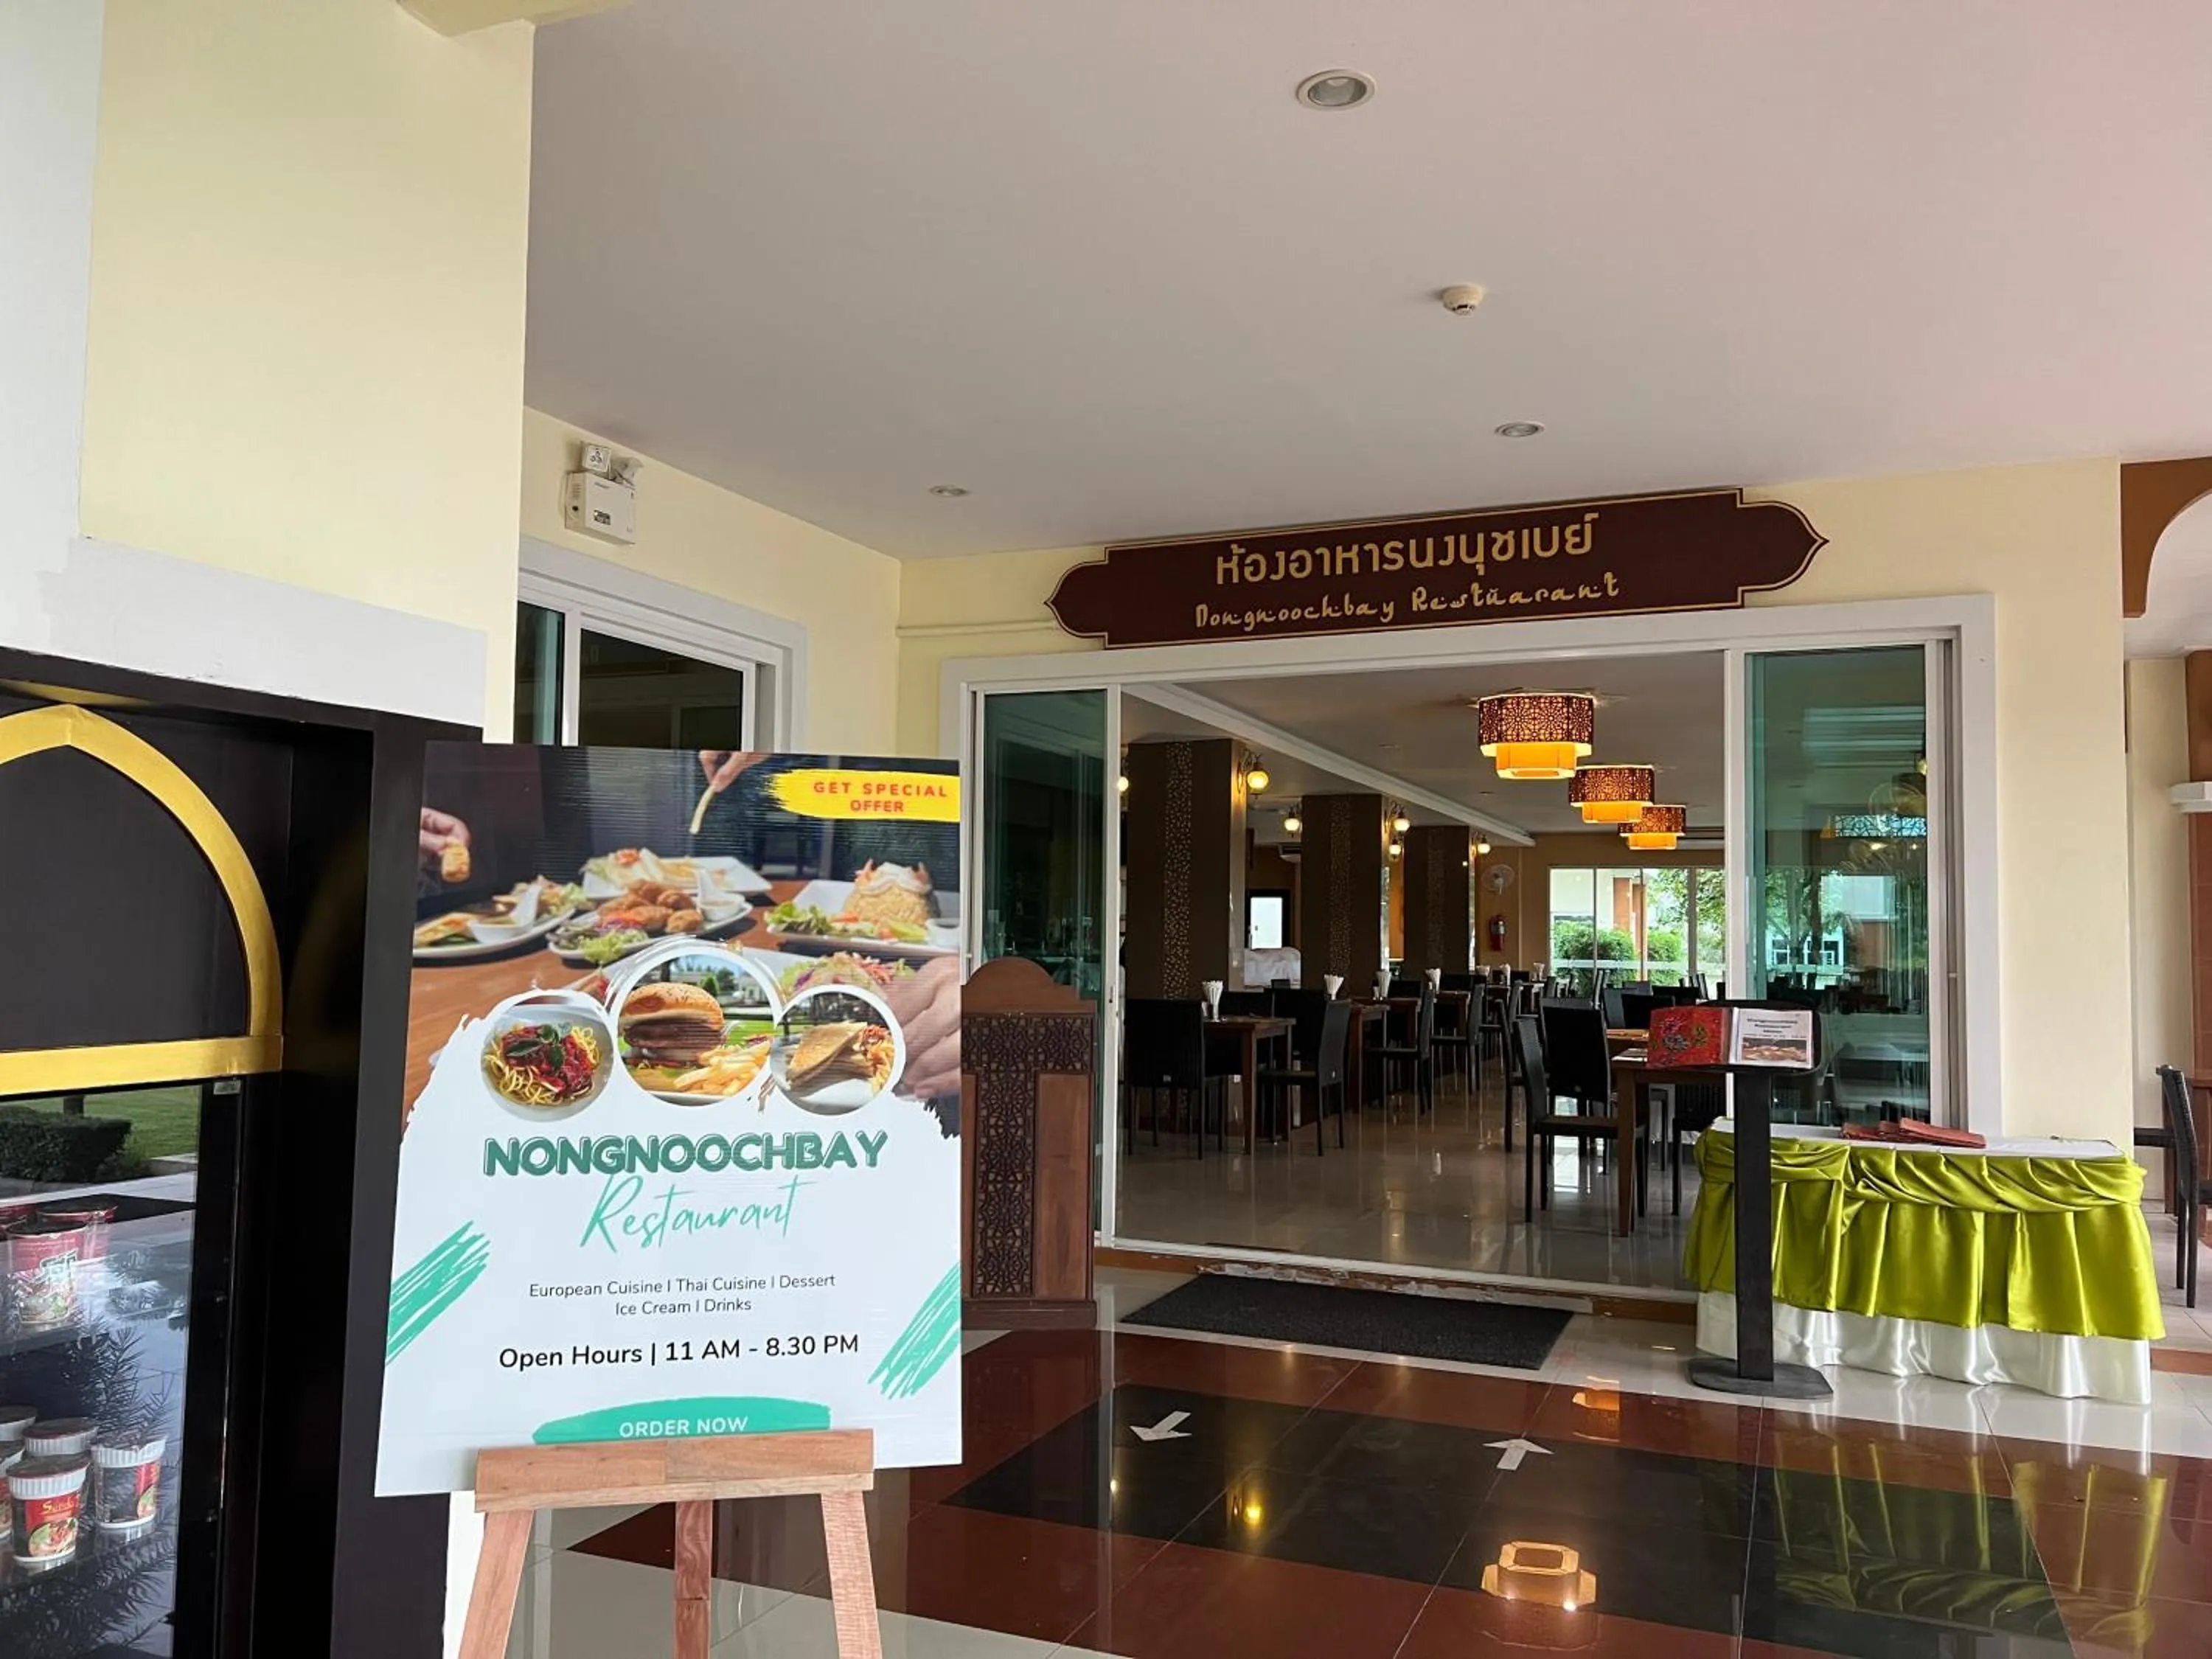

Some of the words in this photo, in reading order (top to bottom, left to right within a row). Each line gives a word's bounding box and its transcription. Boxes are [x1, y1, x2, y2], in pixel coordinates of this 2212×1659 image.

[1217, 512, 1599, 585] ห้องอาหารนงนุชเบย์
[813, 782, 851, 794] GET
[863, 782, 946, 798] SPECIAL
[850, 800, 903, 813] OFFER
[483, 1130, 888, 1176] NONGNOOCHBAY
[579, 1175, 819, 1253] Restaurant
[529, 1284, 602, 1298] European
[607, 1281, 663, 1295] Cuisine
[676, 1278, 707, 1293] Thai
[712, 1277, 766, 1291] Cuisine
[779, 1275, 835, 1288] Dessert
[616, 1302, 637, 1316] Ice
[641, 1301, 691, 1315] Cream
[704, 1297, 751, 1312] Drinks
[499, 1348, 563, 1372] Open
[572, 1345, 642, 1365] Hours
[666, 1341, 694, 1361] 11
[701, 1339, 740, 1360] AM
[766, 1335, 815, 1357] 8.30
[824, 1334, 858, 1354] PM
[619, 1419, 689, 1439] ORDER
[696, 1416, 749, 1435] NOW
